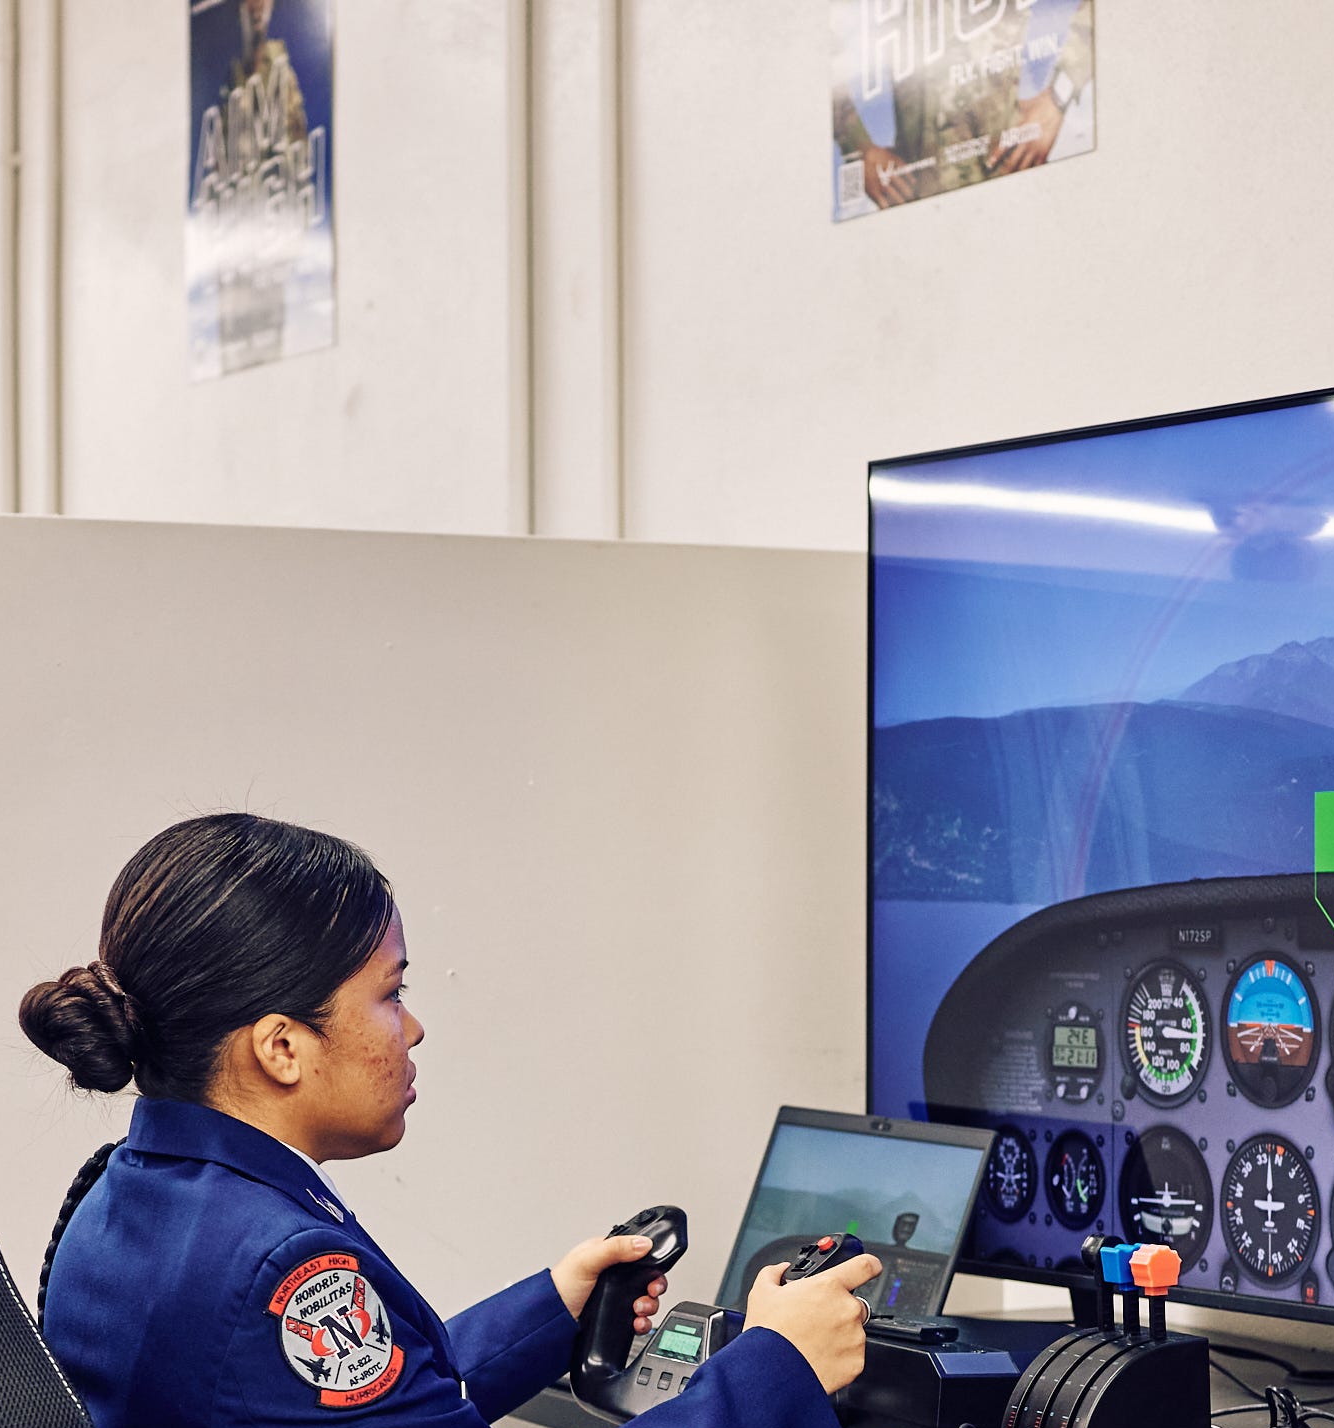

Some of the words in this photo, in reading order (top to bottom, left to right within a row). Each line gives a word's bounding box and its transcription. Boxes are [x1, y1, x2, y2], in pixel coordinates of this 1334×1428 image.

[1179, 930, 1212, 943] N172SP
[1147, 999, 1163, 1010] 200
[1173, 998, 1184, 1008] 40
[1181, 1018, 1192, 1029] 60
[1180, 1042, 1191, 1053] 80
[1151, 1056, 1165, 1067] 120
[1166, 1060, 1180, 1070] 100
[1256, 1153, 1268, 1166] 33
[1274, 1153, 1283, 1167] N
[1241, 1161, 1253, 1178] 30
[1288, 1168, 1296, 1179] 3
[1234, 1183, 1244, 1198] W
[1297, 1194, 1305, 1204] 6
[1234, 1207, 1244, 1225] 24
[1295, 1217, 1305, 1230] E
[1241, 1231, 1253, 1248] 21
[1287, 1237, 1298, 1253] 12
[1257, 1248, 1265, 1261] S
[1271, 1251, 1283, 1264] 15
[275, 1260, 322, 1305] NORTHEAST
[328, 1256, 350, 1266] HIGH
[294, 1272, 340, 1305] HONORIS
[299, 1282, 353, 1319] NOBILITAS
[318, 1304, 364, 1360] N
[348, 1355, 373, 1373] FL-822
[349, 1362, 383, 1387] AF-JROTC
[345, 1367, 397, 1403] HURRICANES
